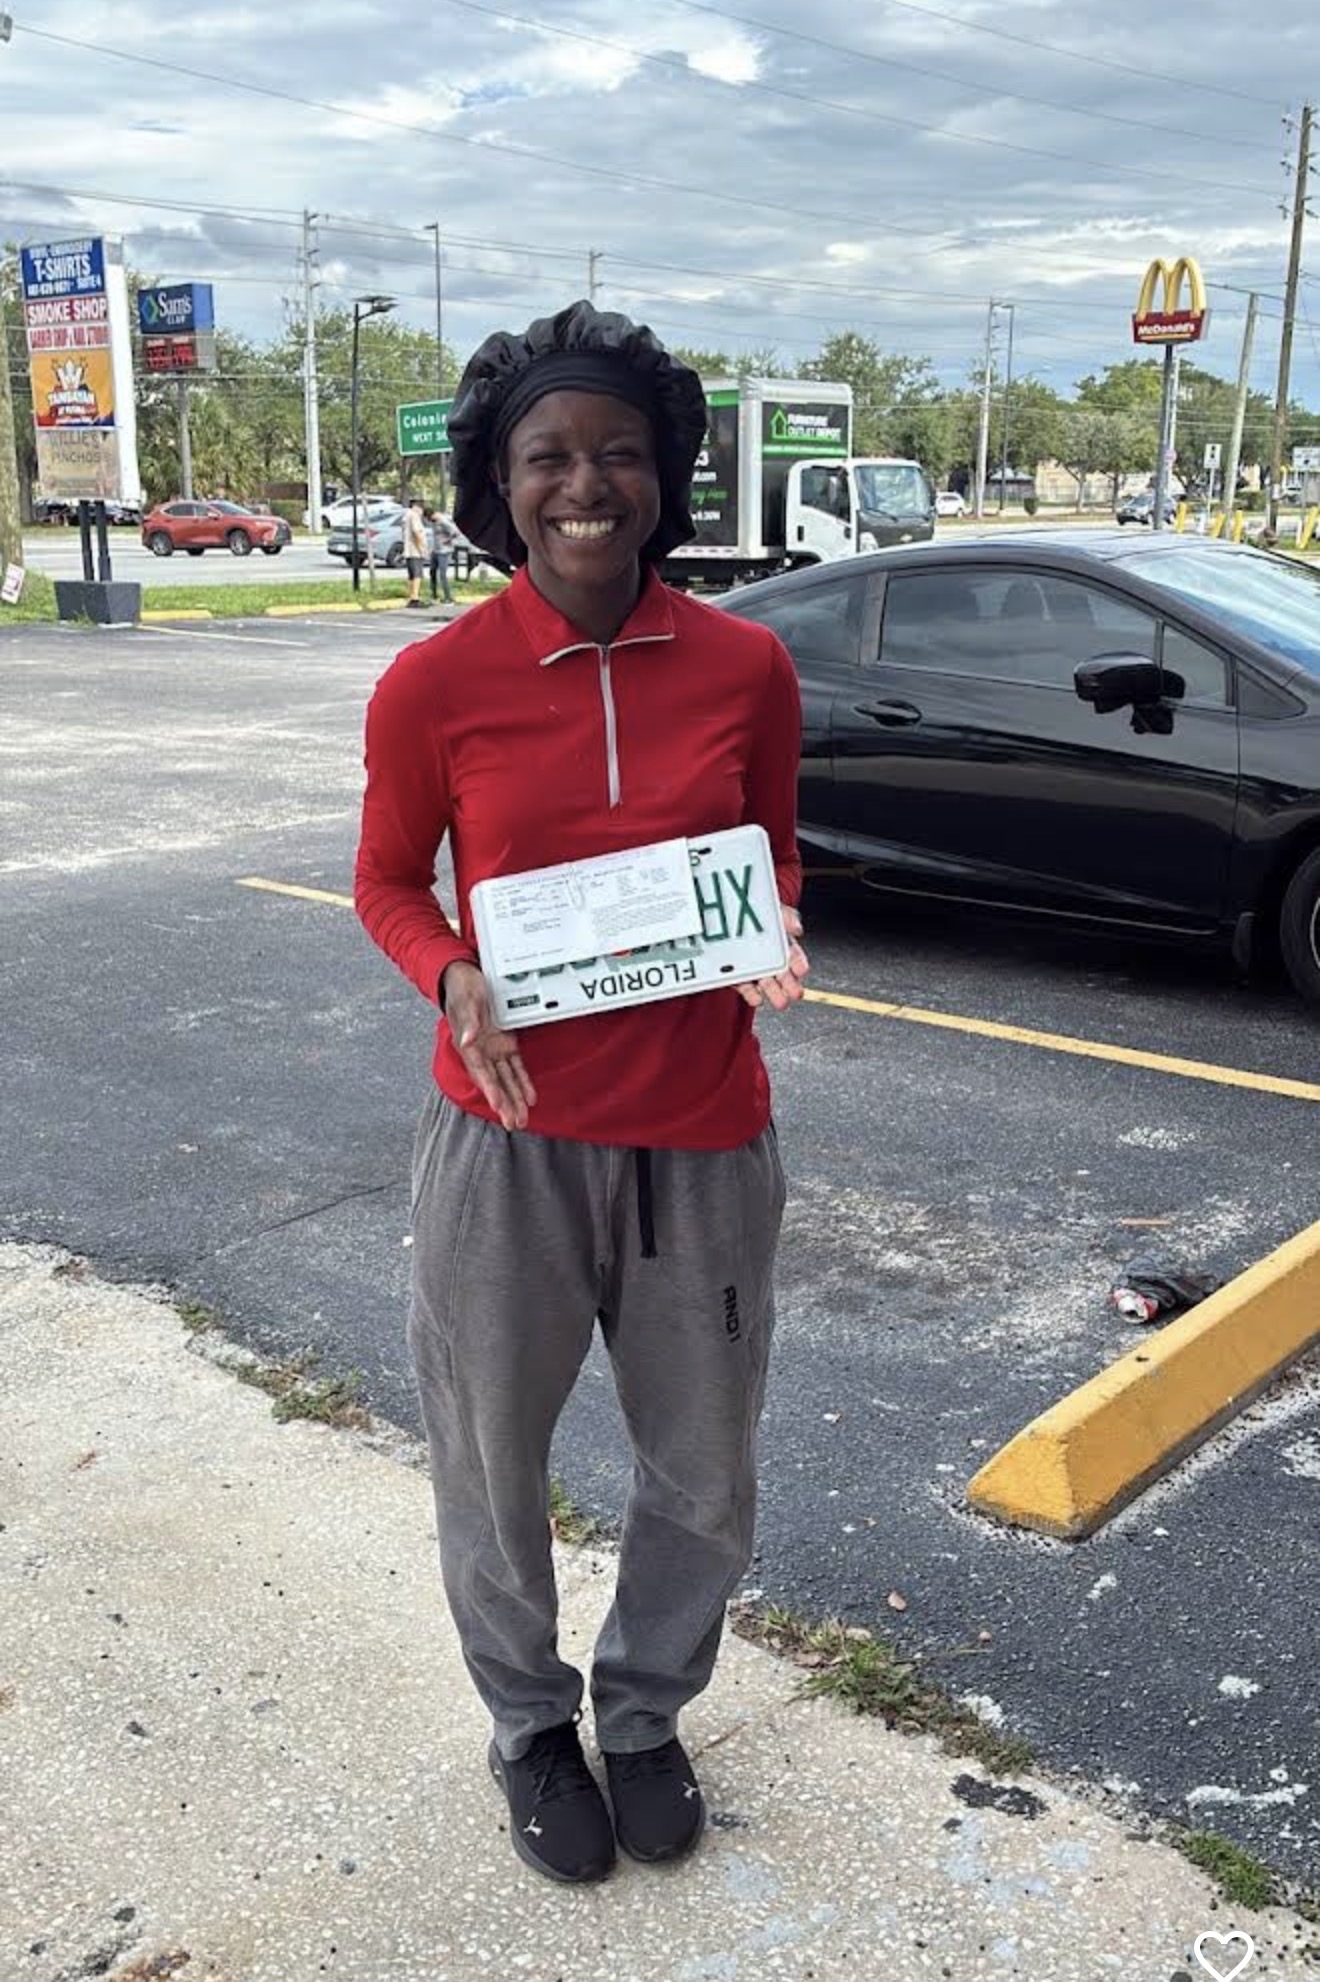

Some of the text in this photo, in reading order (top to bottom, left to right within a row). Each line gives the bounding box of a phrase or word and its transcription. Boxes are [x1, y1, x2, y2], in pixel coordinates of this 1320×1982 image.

[33, 253, 92, 282] T-SHIRTS
[28, 299, 108, 325] SMOKE SHOP
[158, 291, 193, 317] Sam's
[1137, 322, 1196, 336] McDonald's
[579, 959, 697, 1000] FLORIDA
